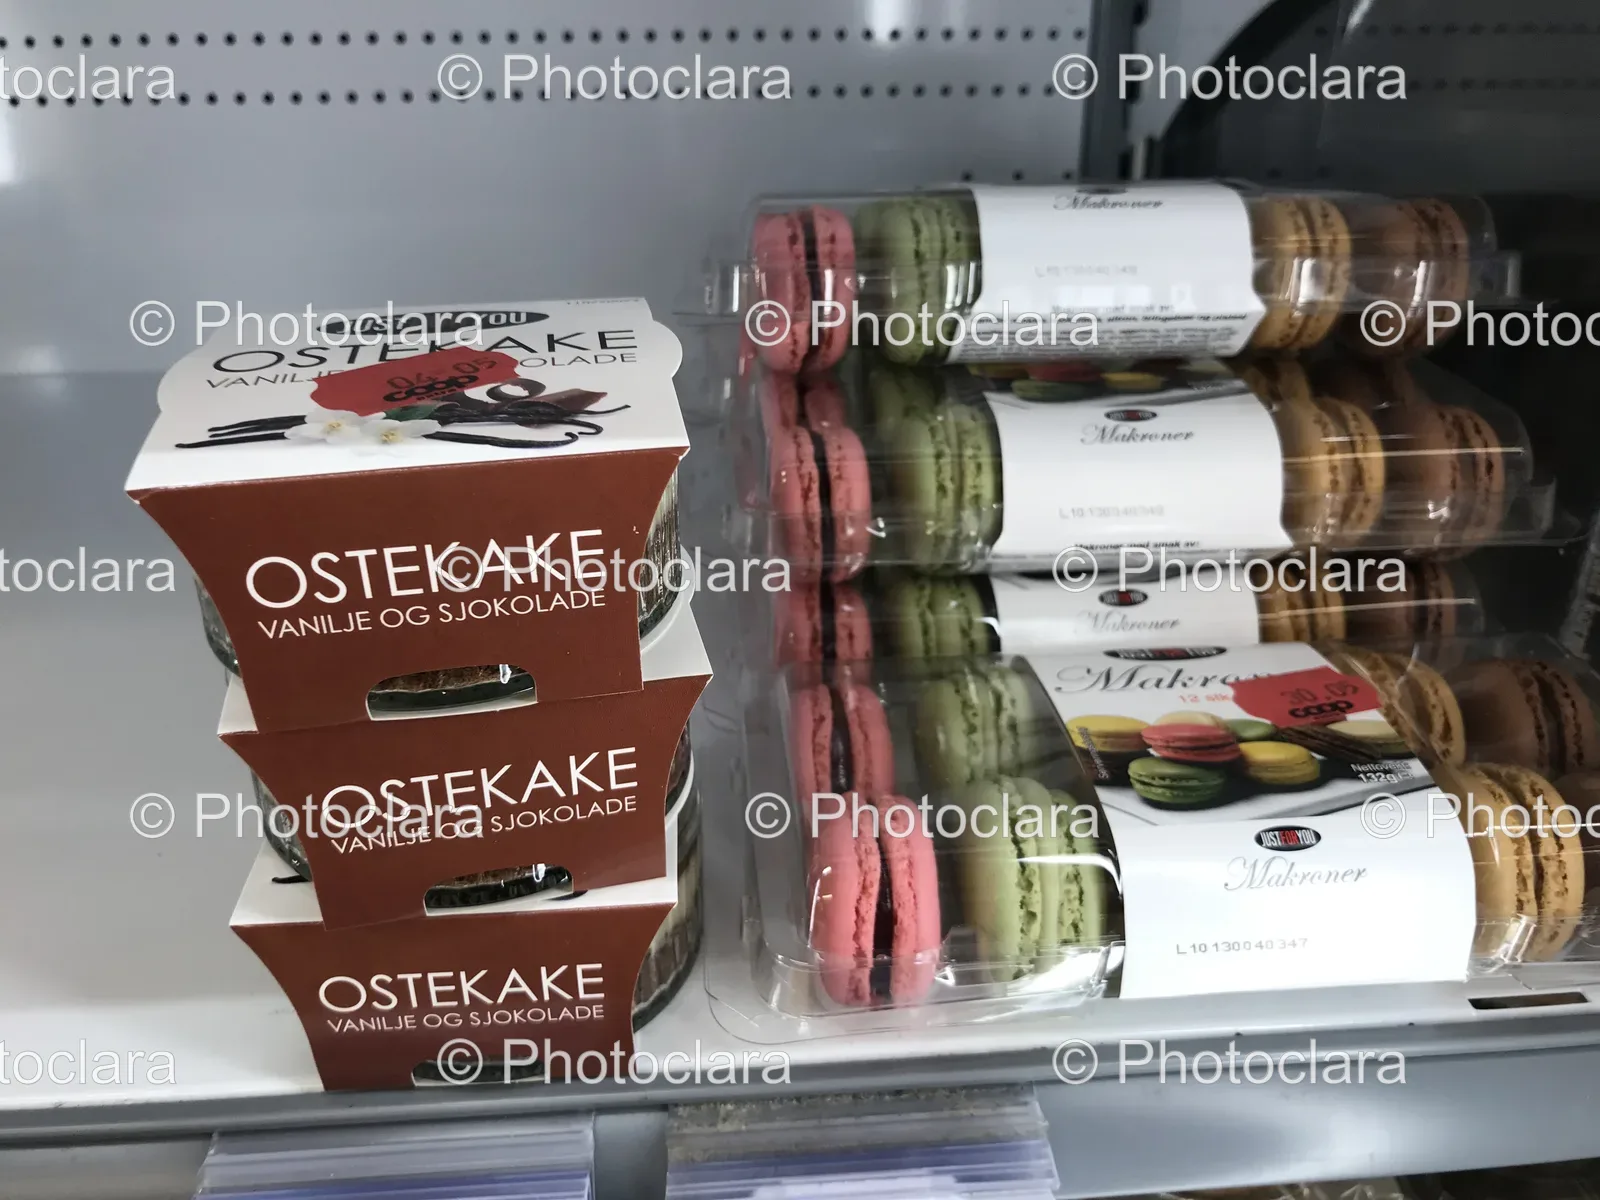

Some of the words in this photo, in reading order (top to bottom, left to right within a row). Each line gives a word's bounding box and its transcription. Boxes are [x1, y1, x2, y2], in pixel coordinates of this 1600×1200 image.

[383, 375, 479, 402] coop
[1080, 422, 1194, 445] Makroner
[246, 529, 606, 609] OSTEKAKE
[258, 610, 373, 639] VANILJE
[379, 604, 431, 629] OG
[438, 588, 606, 623] SJOKOLADE
[1075, 609, 1182, 634] Makroner
[1287, 700, 1354, 719] coop
[321, 746, 639, 829] OSTEKAKE
[330, 825, 432, 854] VANILJE
[438, 819, 484, 840] OG
[490, 795, 638, 833] SJOKOLADE
[1224, 856, 1368, 891] Makroner
[318, 963, 605, 1013] OSTEKAKE
[327, 1014, 417, 1034] VANILJE
[422, 1011, 463, 1028] OG
[469, 1004, 605, 1026] SJOKOLADE
